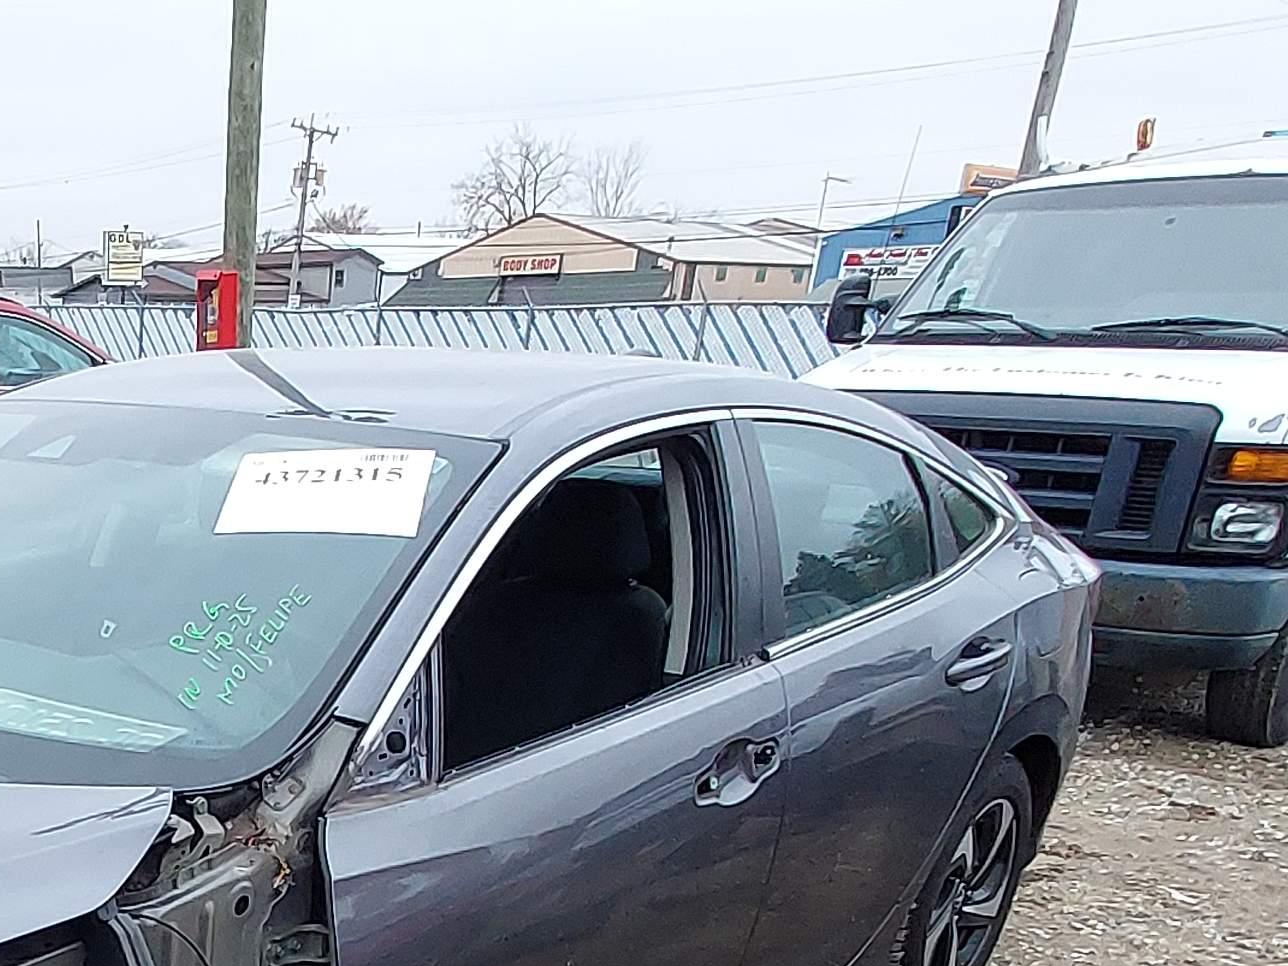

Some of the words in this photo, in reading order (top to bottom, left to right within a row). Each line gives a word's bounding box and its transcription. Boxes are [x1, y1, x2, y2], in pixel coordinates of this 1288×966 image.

[503, 259, 528, 272] BODY
[530, 258, 557, 271] SHOP
[255, 466, 404, 485] 43721315
